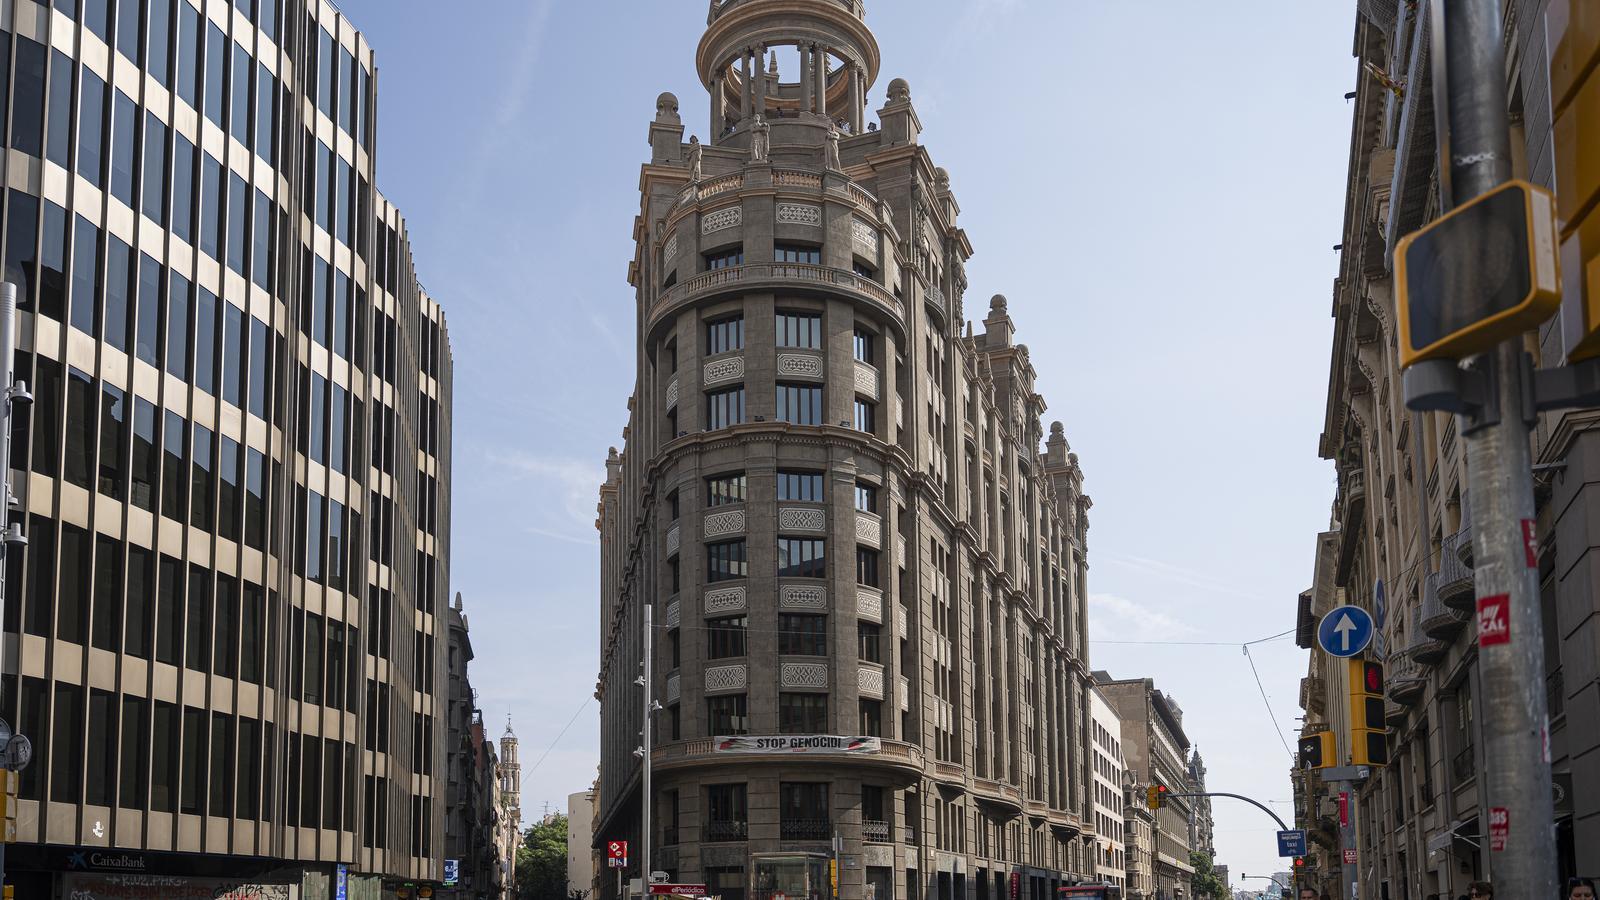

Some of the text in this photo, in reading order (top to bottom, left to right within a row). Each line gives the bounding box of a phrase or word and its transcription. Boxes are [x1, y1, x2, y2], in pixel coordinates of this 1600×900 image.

[756, 737, 841, 749] STOP GENOCIDI
[90, 852, 145, 869] CaixaBank
